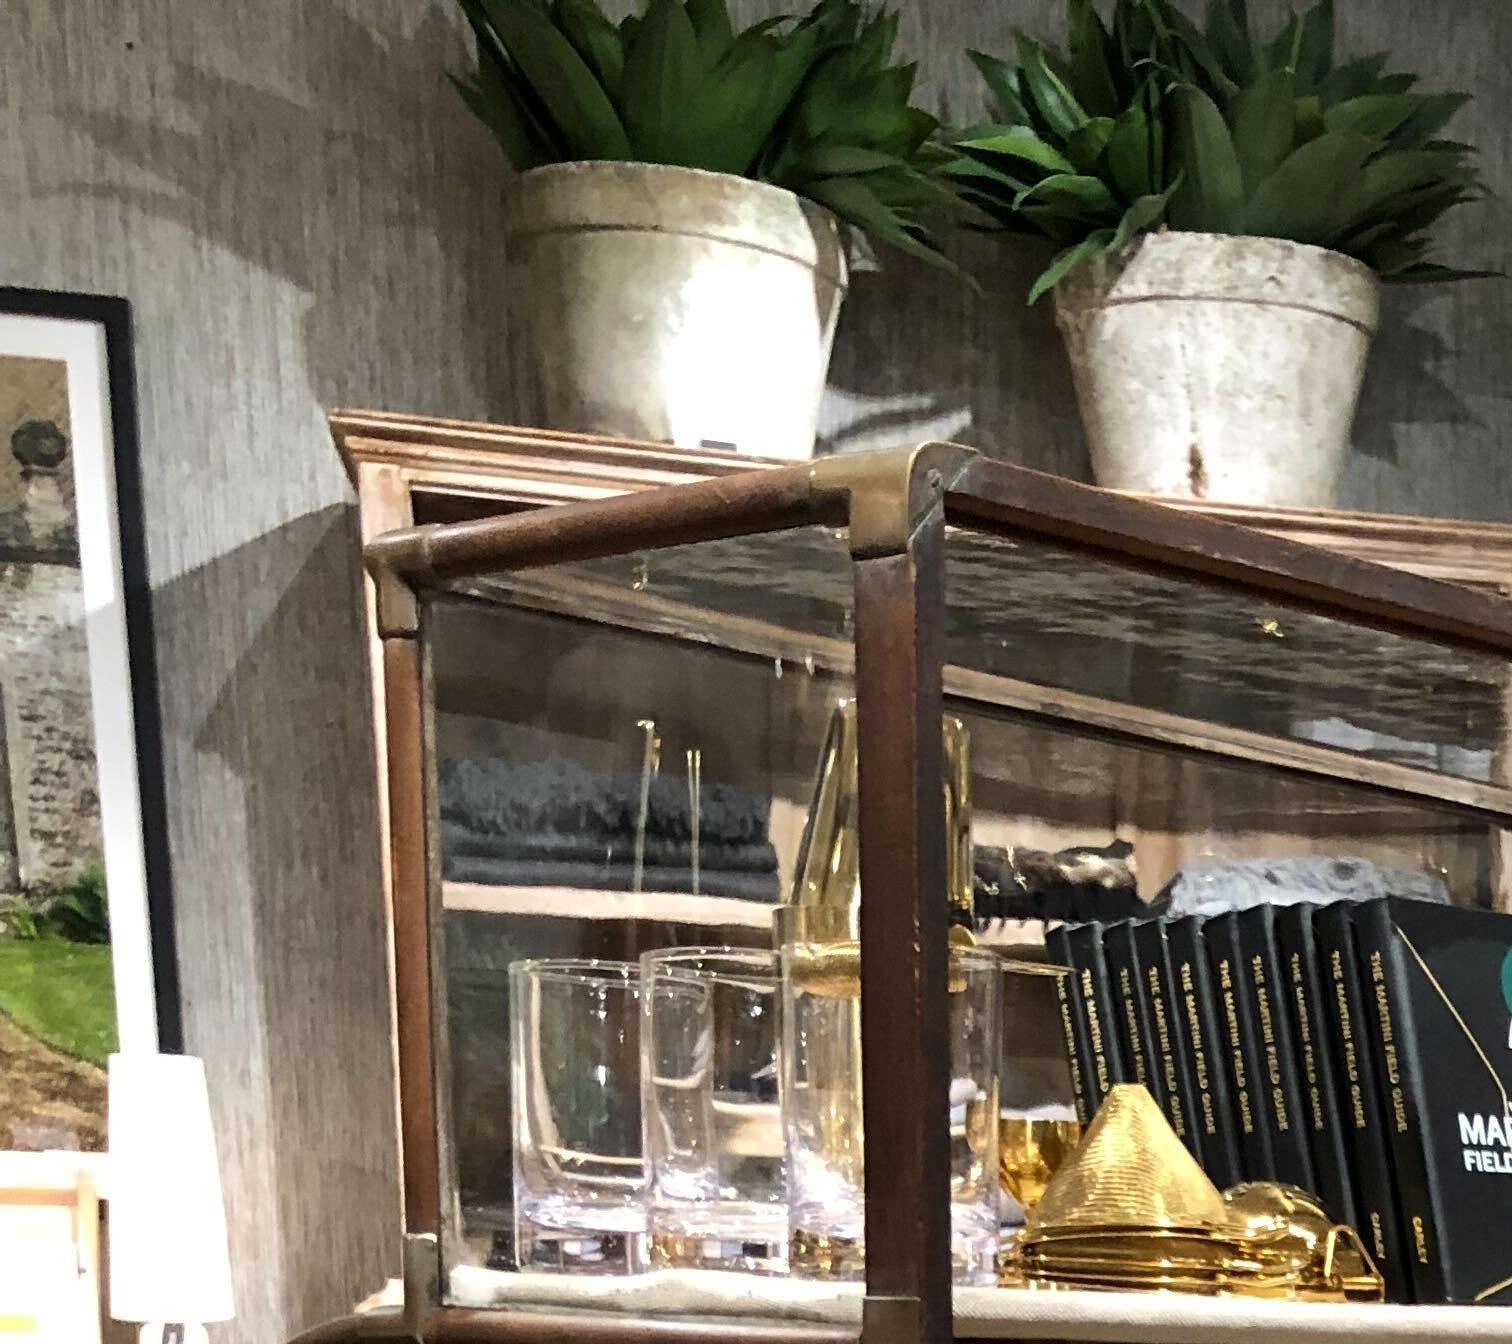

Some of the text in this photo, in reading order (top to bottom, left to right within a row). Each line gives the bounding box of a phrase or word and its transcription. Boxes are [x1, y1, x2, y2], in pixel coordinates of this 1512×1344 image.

[1082, 967, 1109, 1092] THE MARTINI FIELD
[1120, 966, 1147, 1084] THE MARTINI FIEL
[1149, 966, 1161, 995] THE
[1154, 998, 1170, 1052] MARTINI
[1181, 961, 1216, 1135] THE MARTINI FIELD GUIDE
[1219, 959, 1253, 1133] THE MARTINI FIELD GUIDE
[1252, 954, 1289, 1131] THE MARTINI FIELD GUIDE
[1290, 952, 1324, 1131] THE MARTINI FIELD GUIDE
[1331, 950, 1366, 1128] THE MARTINI FIELD GUIDE
[1370, 950, 1408, 1133] THE MARTINI FIELD GUIDE
[1163, 1055, 1177, 1092] FIELD
